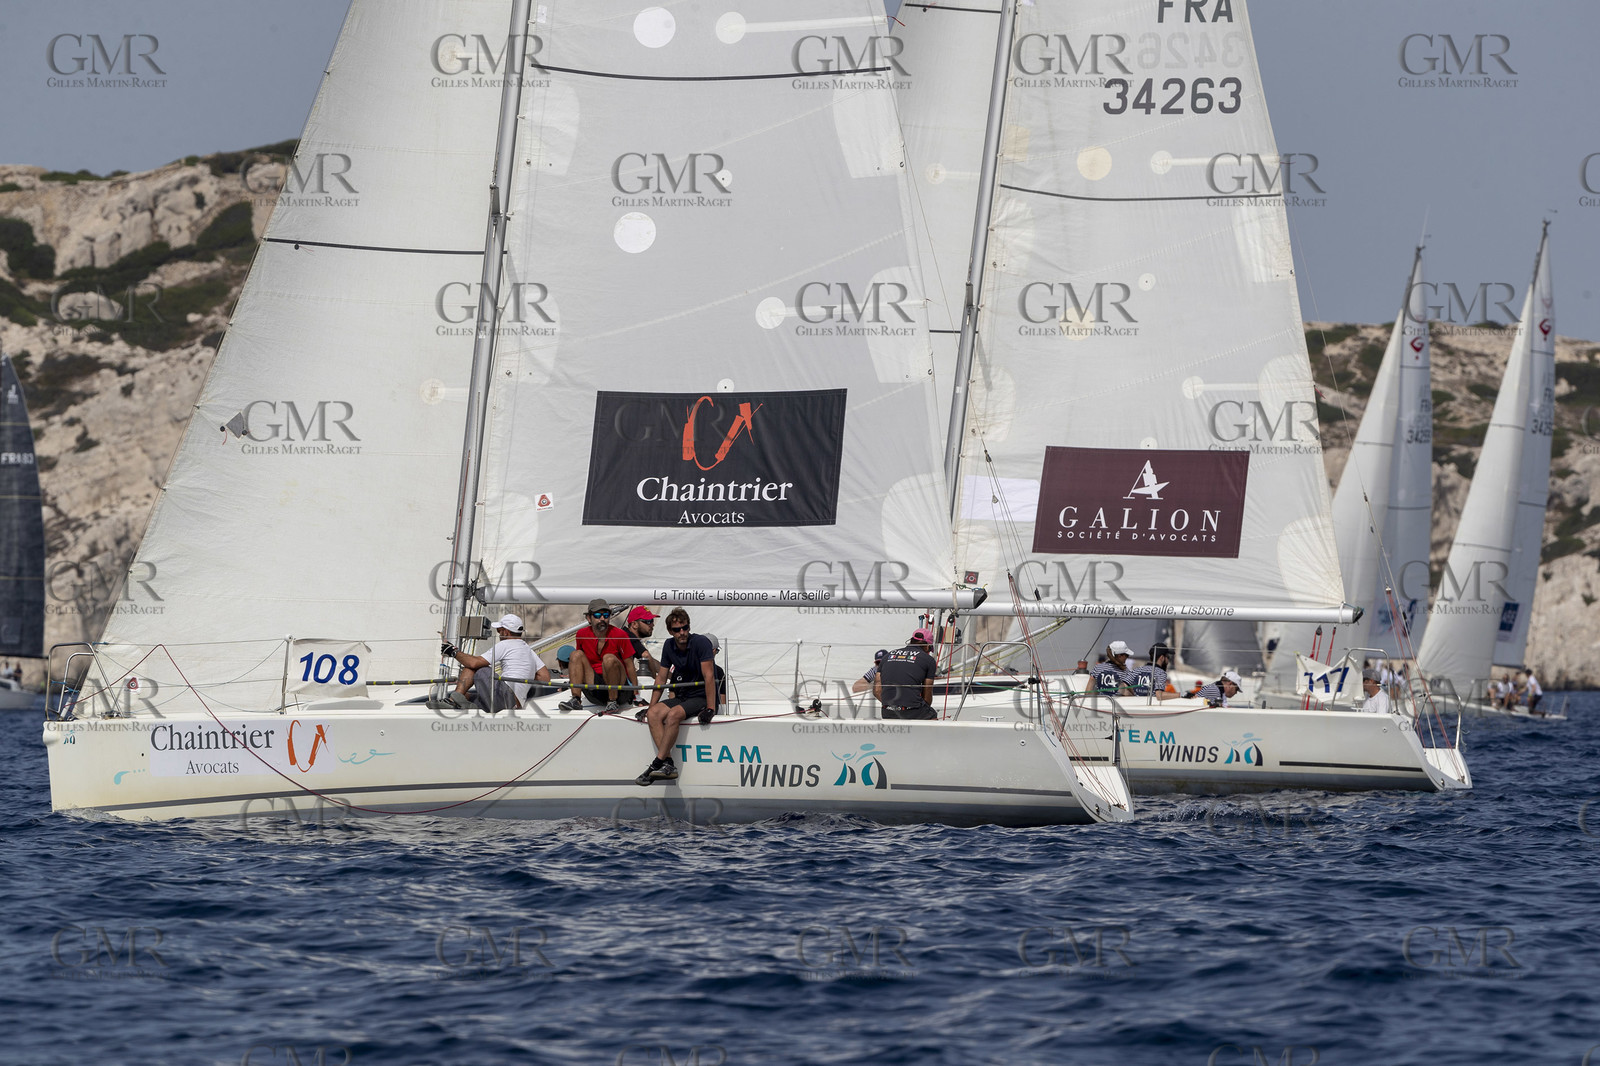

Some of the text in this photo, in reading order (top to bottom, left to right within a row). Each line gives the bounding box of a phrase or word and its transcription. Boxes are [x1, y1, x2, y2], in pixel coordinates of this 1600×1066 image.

[1103, 77, 1242, 115] 34263
[636, 476, 793, 501] Chaintrier
[678, 510, 745, 525] Avocats
[1058, 506, 1221, 532] GALION
[1057, 530, 1217, 543] SOCIÉTÉ D'AVOCATS
[653, 590, 668, 601] La
[671, 589, 706, 601] Trinité
[716, 590, 769, 601] Lisbonne
[779, 590, 831, 601] Marseille
[1063, 603, 1078, 614] La
[1181, 605, 1235, 617] Lisbonne
[300, 651, 360, 685] 108
[151, 724, 275, 751] Chaintrier
[676, 744, 762, 763] TEAM
[1159, 745, 1219, 763] WINDS
[185, 760, 240, 775] Avocats
[740, 764, 821, 787] WINDS
